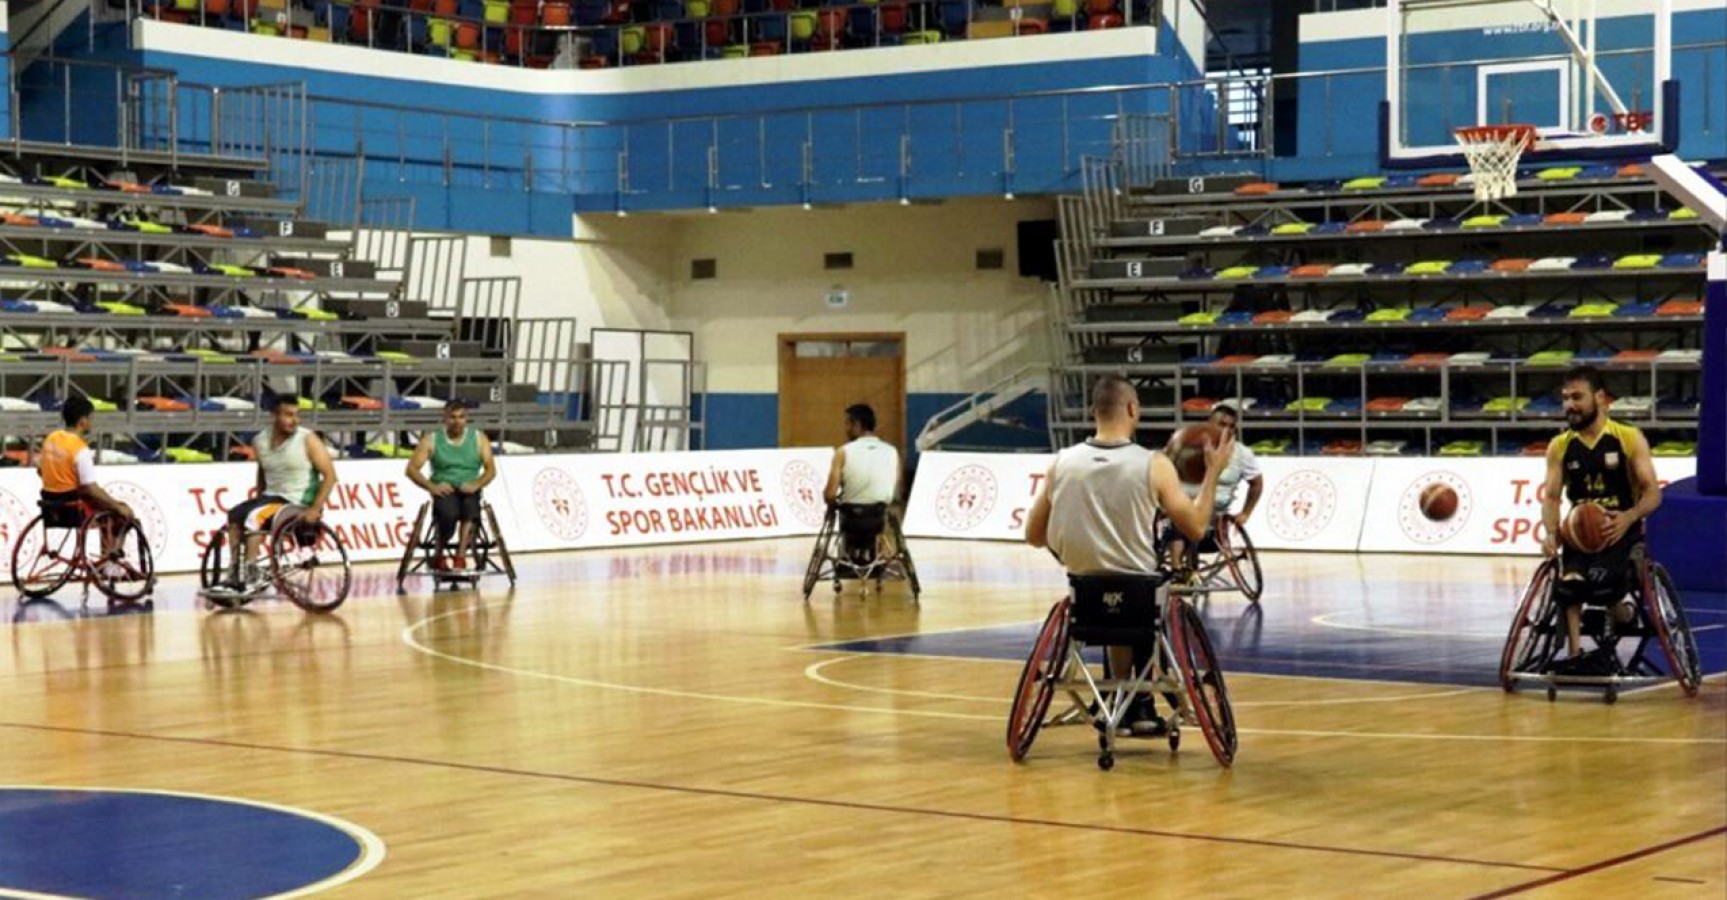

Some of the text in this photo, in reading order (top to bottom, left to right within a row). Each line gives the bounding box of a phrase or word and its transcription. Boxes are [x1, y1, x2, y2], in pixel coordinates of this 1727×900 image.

[1612, 111, 1654, 131] TBF
[188, 487, 229, 515] T.C
[366, 482, 403, 508] VE
[602, 465, 763, 501] T.C. GENÇLİK VE
[606, 499, 778, 535] SPOR BAKANLIĞI
